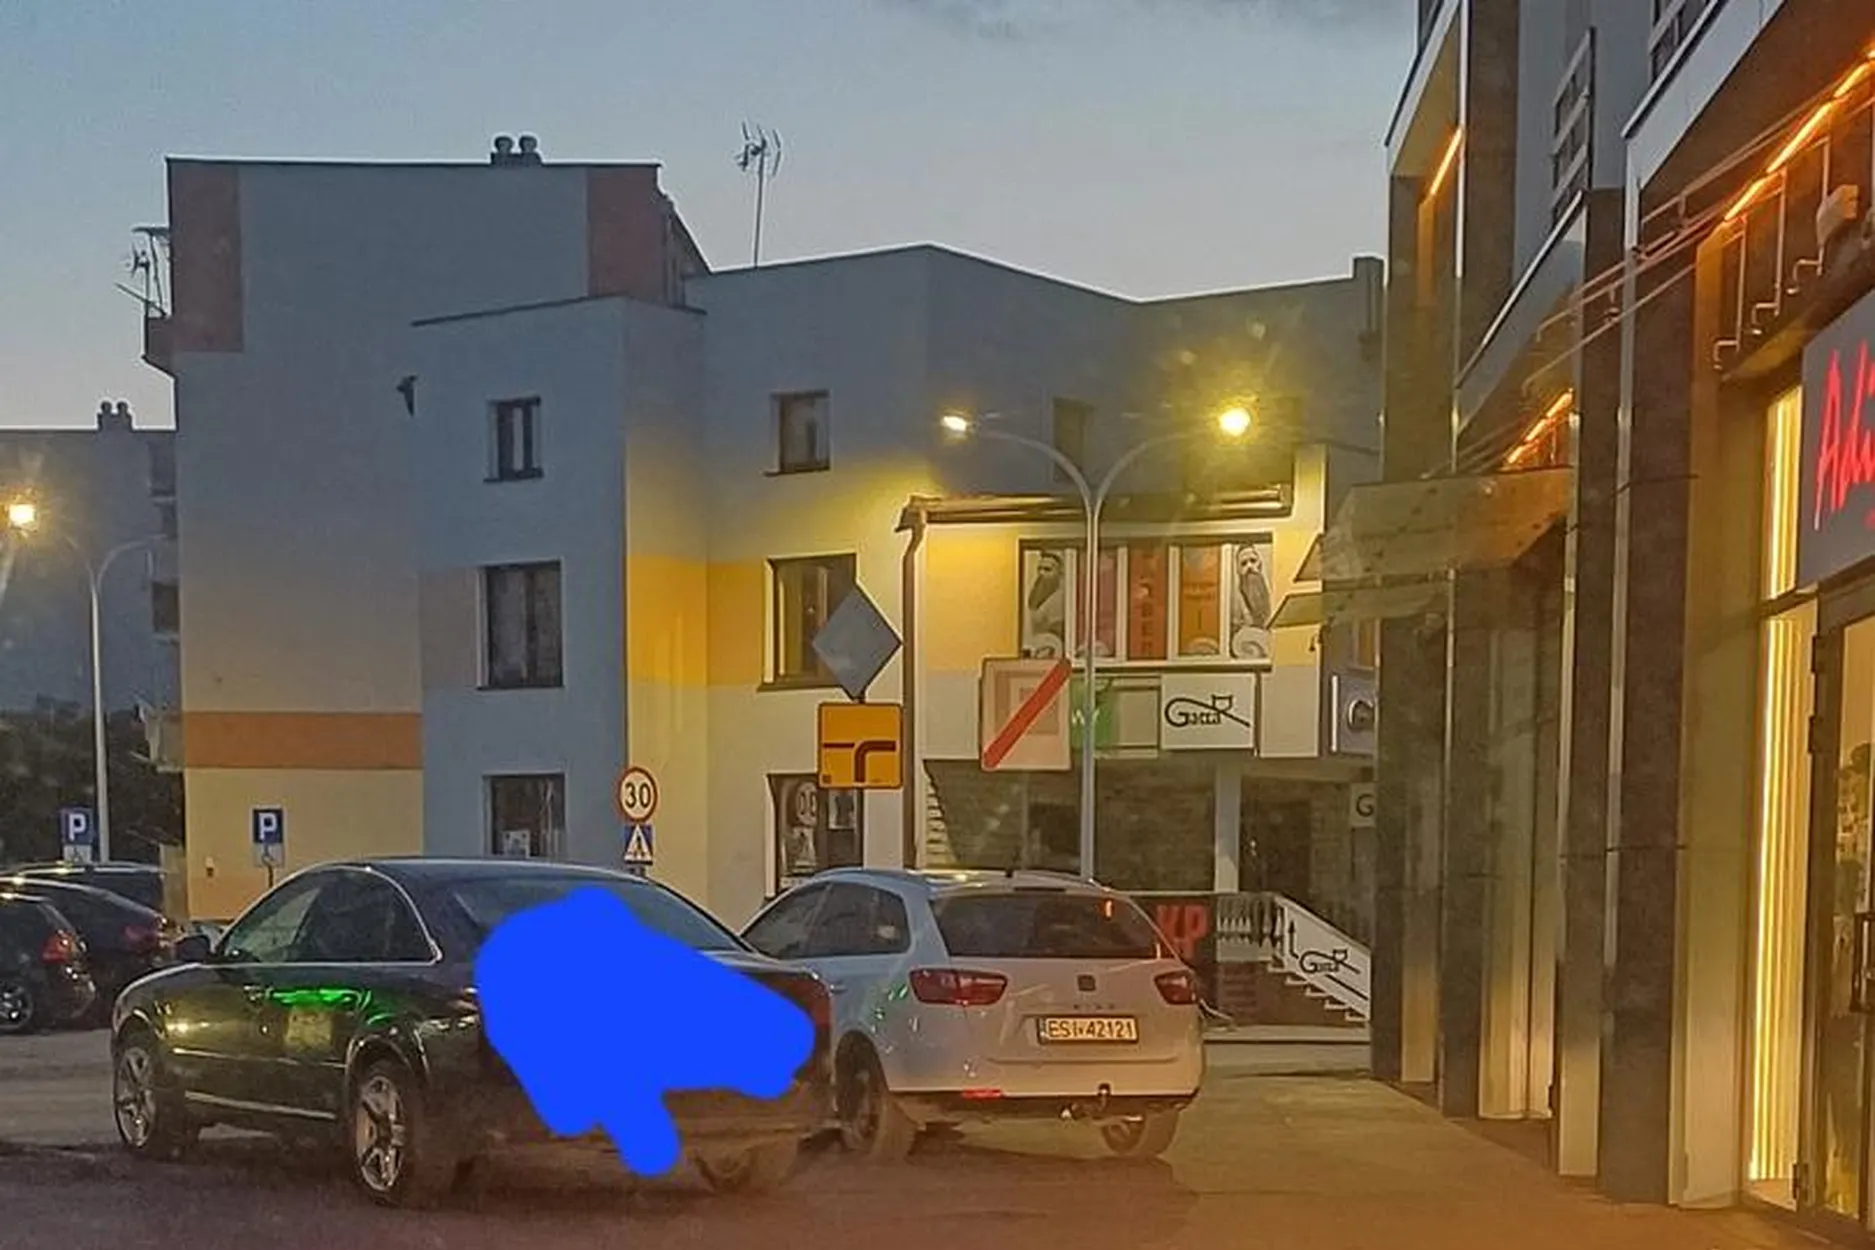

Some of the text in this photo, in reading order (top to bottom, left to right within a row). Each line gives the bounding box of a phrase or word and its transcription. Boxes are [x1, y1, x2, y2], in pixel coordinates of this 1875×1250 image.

[625, 781, 651, 808] 30
[68, 813, 86, 841] P
[259, 812, 277, 840] P
[1086, 1020, 1134, 1038] 42121
